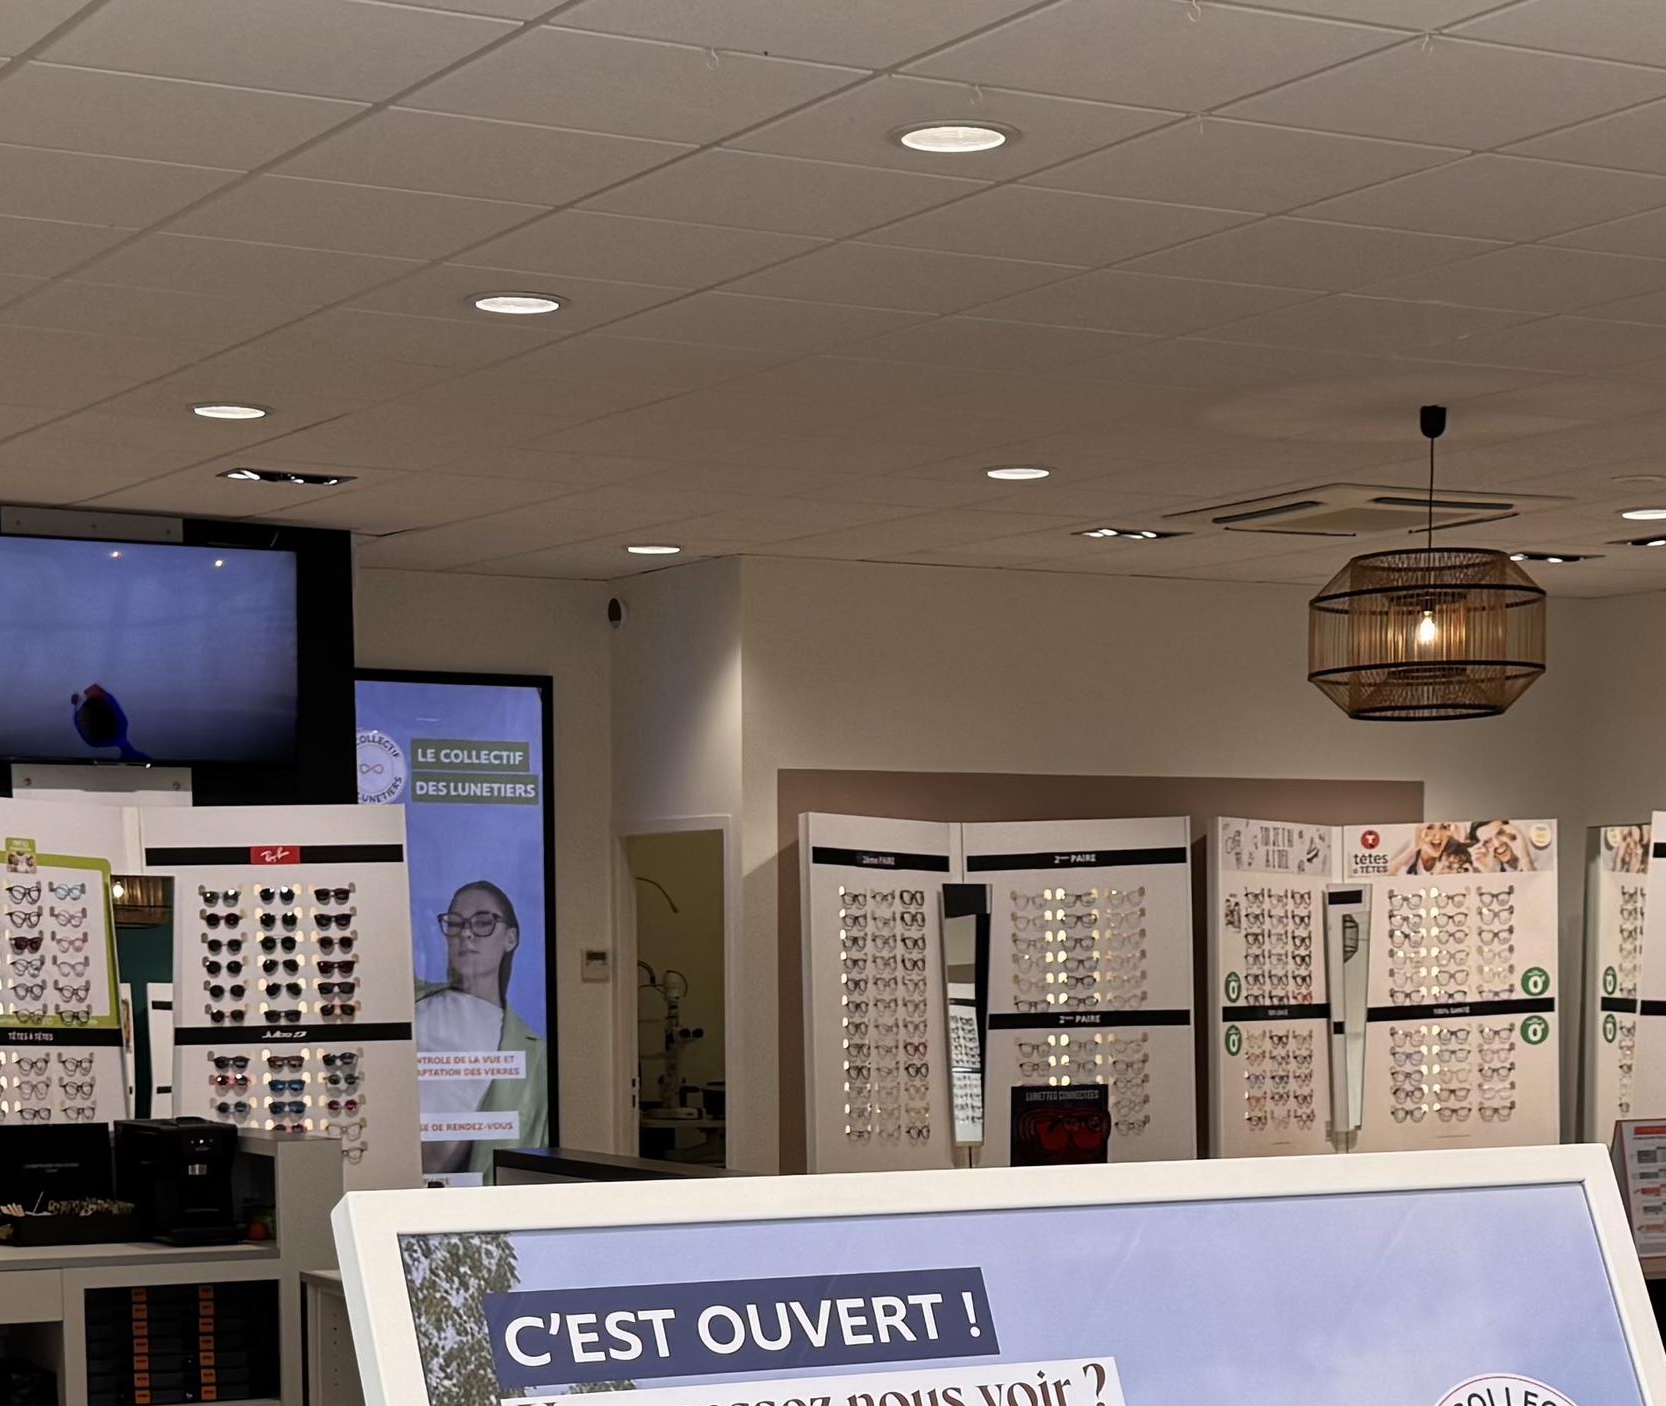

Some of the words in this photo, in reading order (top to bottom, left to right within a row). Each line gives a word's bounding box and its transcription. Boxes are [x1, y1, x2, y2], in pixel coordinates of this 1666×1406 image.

[417, 748, 436, 763] LE
[440, 749, 524, 765] COLLECTIF
[415, 781, 447, 796] DES
[450, 782, 536, 798] LUNETIERS
[1070, 854, 1097, 863] PAIRE
[1353, 852, 1389, 865] têtes
[1075, 1014, 1101, 1023] PAIRE
[469, 1055, 479, 1064] LA
[464, 1068, 482, 1076] DES
[446, 1122, 514, 1131] RENDEZ-VOUS
[698, 1292, 944, 1355] OUVERT
[961, 1291, 984, 1338] !
